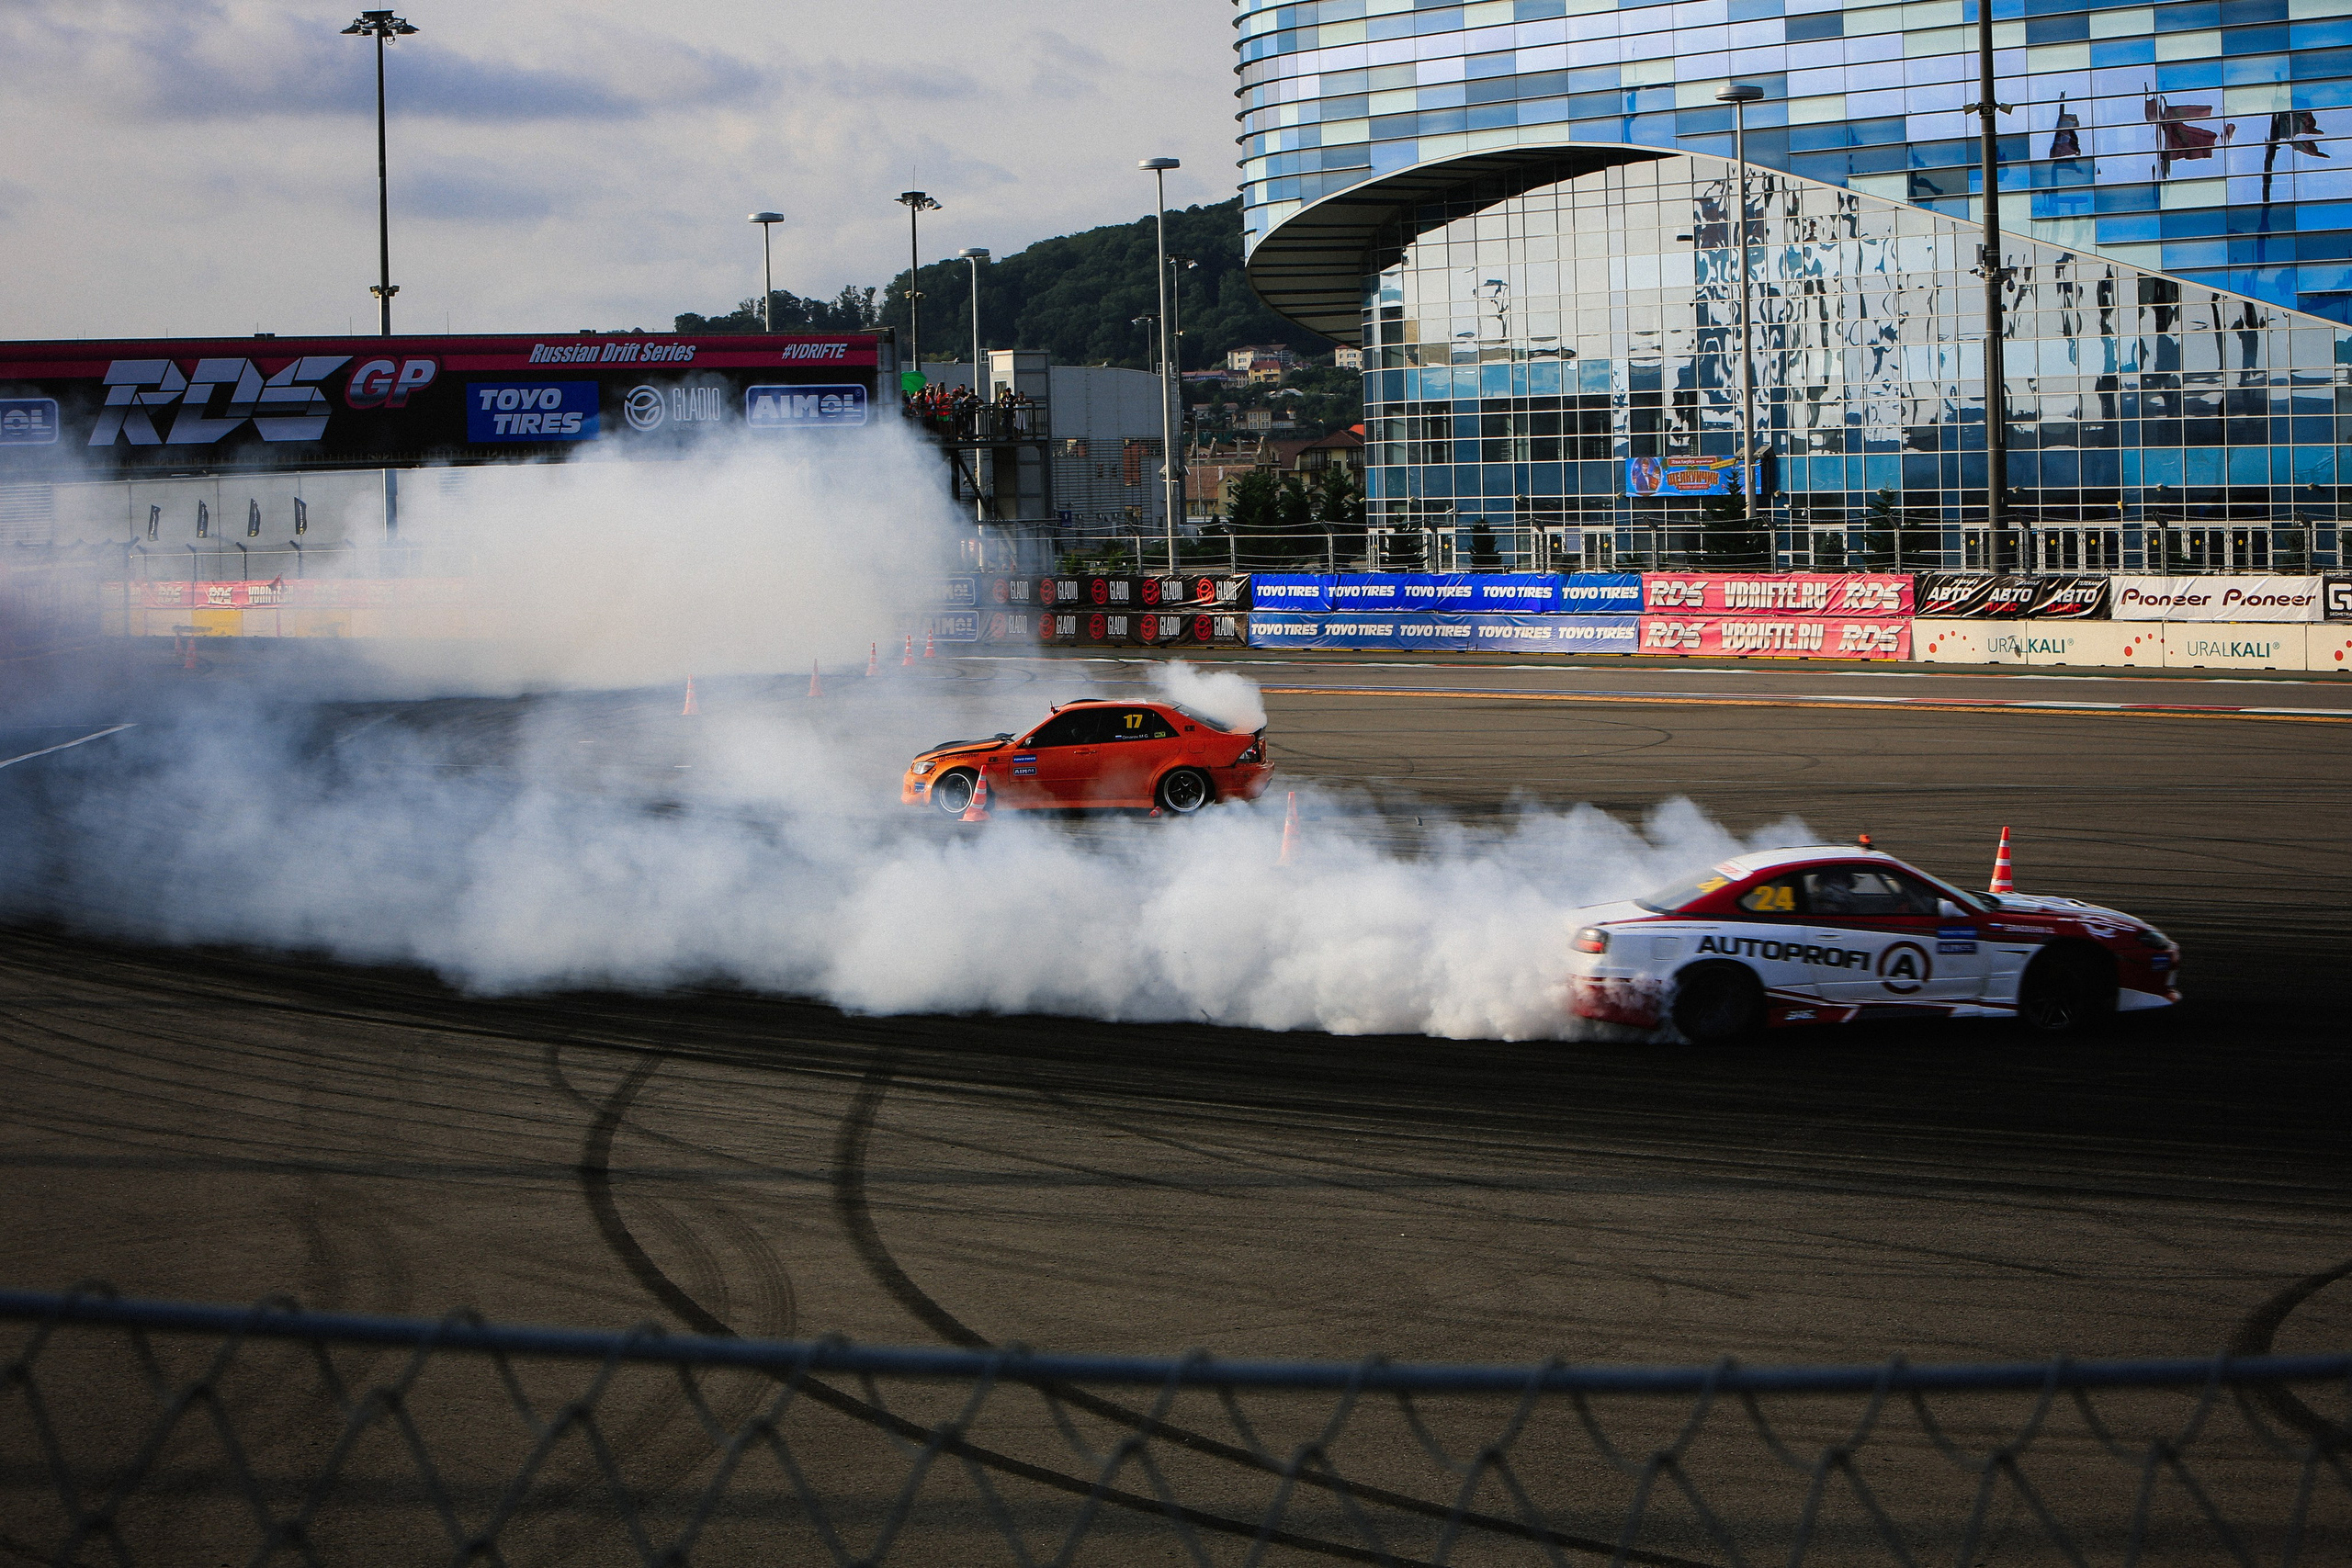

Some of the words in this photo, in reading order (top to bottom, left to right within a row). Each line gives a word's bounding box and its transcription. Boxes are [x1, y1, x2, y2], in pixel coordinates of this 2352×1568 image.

[528, 344, 599, 364] Russian
[600, 343, 640, 363] Drift
[640, 342, 696, 362] Series
[782, 343, 847, 359] #VDRIFTE
[347, 358, 438, 408] GP
[88, 355, 354, 446] RDS
[479, 388, 562, 411] TOYO
[672, 387, 720, 422] GLADIO
[0, 409, 52, 435] OL
[493, 412, 583, 434] TIRES
[1010, 581, 1029, 600] GLADIO
[1057, 581, 1079, 600] GLADIO
[1109, 581, 1129, 601] GLADIO
[1161, 581, 1183, 601] GLADIO
[1216, 581, 1237, 601] GLADIO
[1257, 585, 1285, 597] TOYO
[1286, 586, 1319, 597] TIRES
[1329, 586, 1360, 597] TOYO
[1362, 585, 1396, 597] TIRES
[1405, 585, 1435, 597] TOYO
[1436, 586, 1473, 597] TIRES
[1483, 586, 1516, 598] TOYO
[1517, 586, 1553, 598] TIRES
[1562, 587, 1599, 599] TOYO
[1600, 586, 1639, 599] TIRES
[1648, 581, 1709, 607] RDS
[1724, 581, 1828, 609] VDRIFTE.RU
[1843, 581, 1905, 610] RDS
[1927, 586, 1972, 601] АВТО
[1988, 588, 2032, 603] АВТО
[2054, 589, 2098, 603] АВТО
[2121, 588, 2211, 606] Pioneer
[2222, 588, 2316, 606] Pioneer
[1985, 603, 2018, 612] ПЛЮС
[2047, 604, 2082, 613] ПЛЮС
[1008, 615, 1028, 634] GLADIO
[1057, 615, 1076, 635] GLADIO
[1107, 615, 1127, 636] GLADIO
[1159, 616, 1181, 636] GLADIO
[1214, 616, 1235, 637] GLADIO
[1251, 624, 1282, 636] TOYO
[1283, 624, 1318, 636] TIRES
[1325, 624, 1357, 636] TOYO
[1358, 625, 1394, 637] TIRES
[1400, 625, 1434, 637] TOYO
[1434, 626, 1472, 637] TIRES
[1478, 626, 1512, 637] TOYO
[1513, 626, 1553, 638] TIRES
[1558, 626, 1595, 638] TOYO
[1596, 626, 1635, 639] TIRES
[1645, 622, 1706, 649] RDS
[1721, 623, 1824, 650] VDRIFTE.RU
[1838, 624, 1904, 652] RDS
[1124, 714, 1143, 728] 17
[1753, 886, 1795, 911] 24
[1697, 935, 1871, 971] AUTOPROFI
[1889, 953, 1919, 980] A
